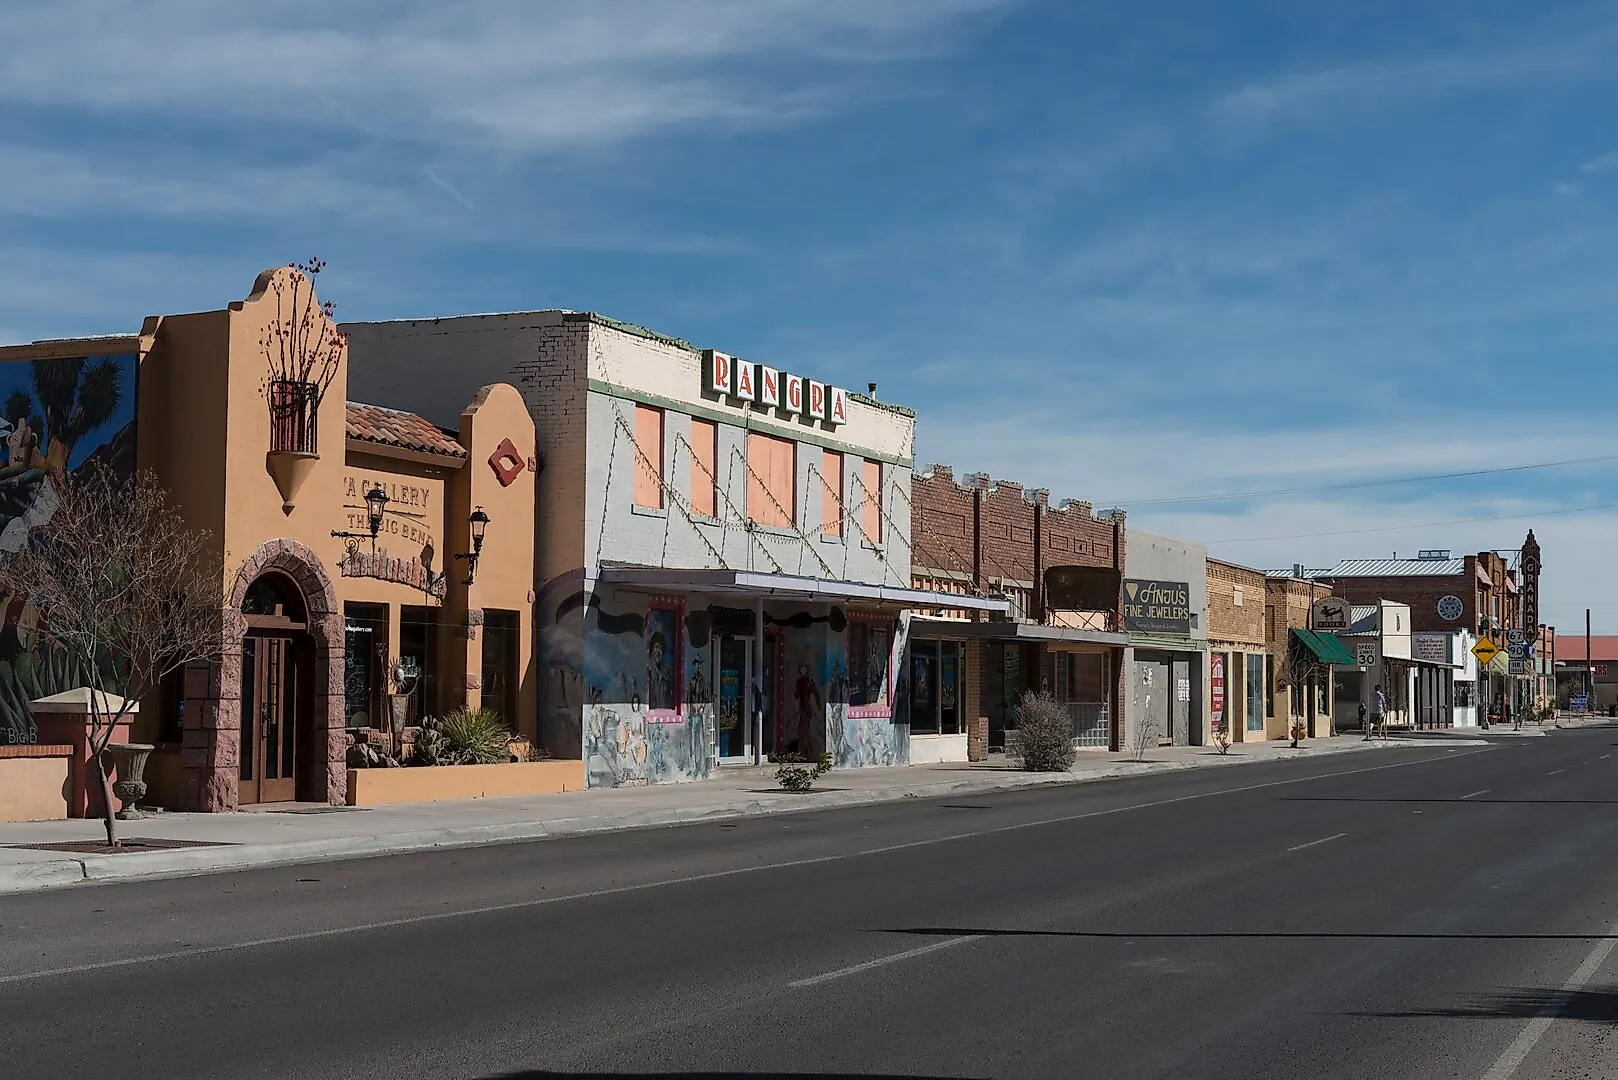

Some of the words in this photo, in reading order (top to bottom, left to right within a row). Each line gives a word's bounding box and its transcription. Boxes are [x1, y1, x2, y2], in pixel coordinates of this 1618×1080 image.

[715, 355, 845, 421] RANGRA
[361, 479, 430, 508] GLERY
[1526, 563, 1534, 634] GRANADA
[1125, 604, 1144, 618] FINE
[1146, 605, 1189, 620] JEWELERS
[1509, 631, 1523, 640] 67
[1508, 646, 1523, 655] 90
[1358, 654, 1375, 664] 30
